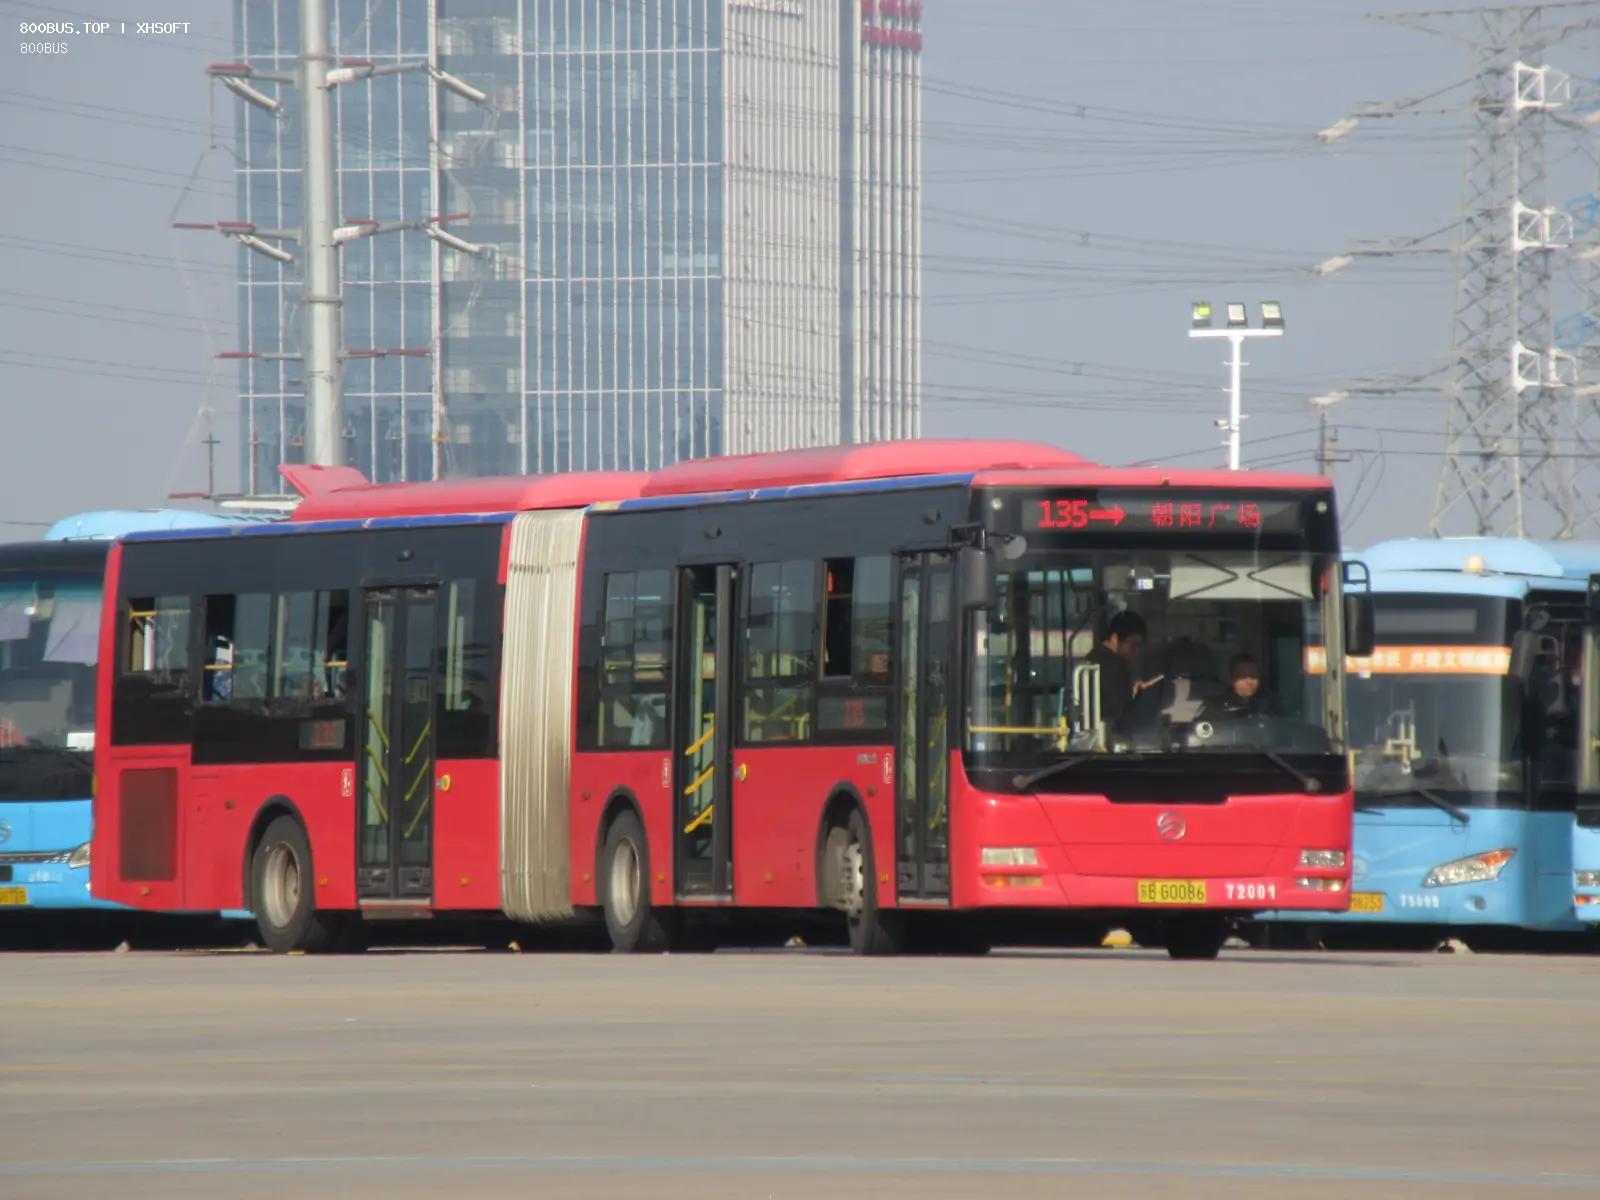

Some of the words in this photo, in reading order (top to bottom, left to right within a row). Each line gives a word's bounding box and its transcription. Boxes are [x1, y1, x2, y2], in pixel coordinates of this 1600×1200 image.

[1038, 500, 1088, 527] 135
[1152, 502, 1261, 527] 朝阳广场
[1226, 884, 1277, 900] 72001
